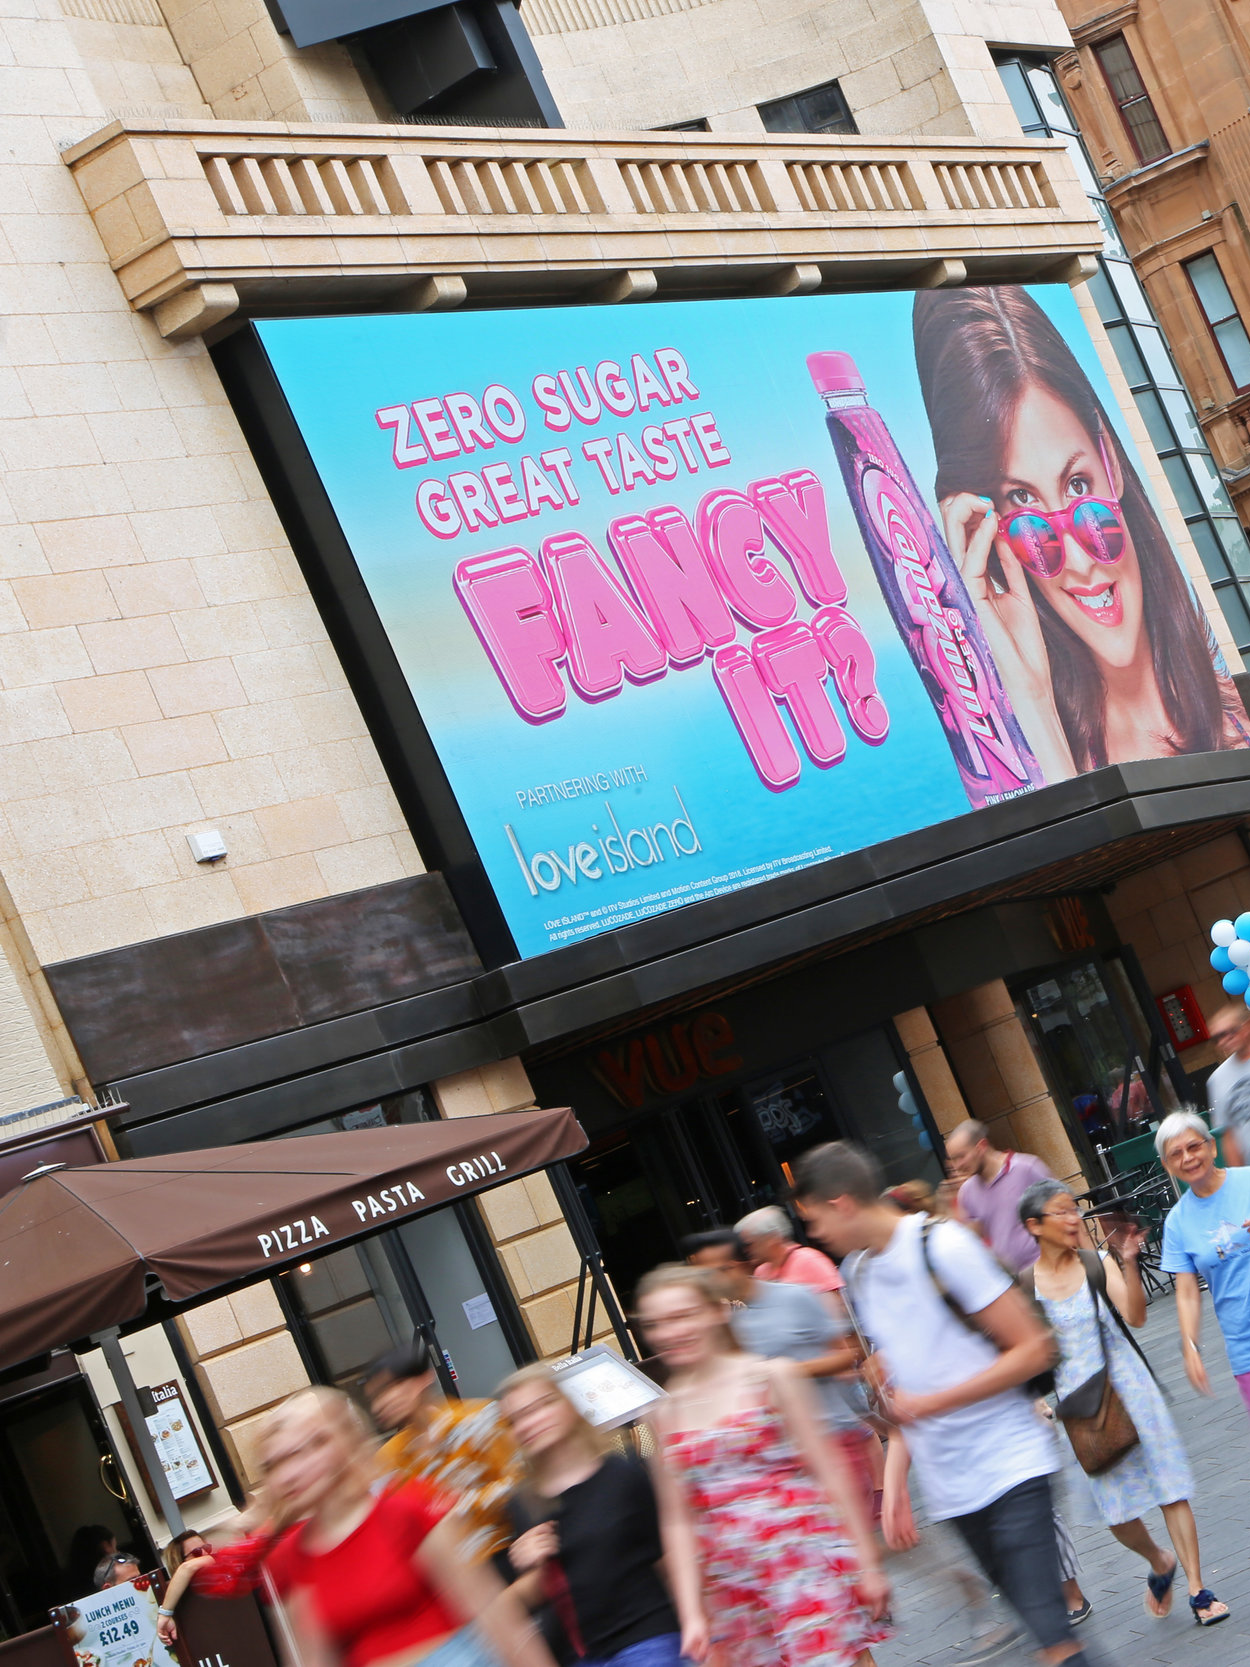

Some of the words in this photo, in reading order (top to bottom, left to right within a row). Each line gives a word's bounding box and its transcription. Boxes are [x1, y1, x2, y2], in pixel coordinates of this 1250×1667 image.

[376, 384, 527, 469] ZERO
[532, 347, 700, 432] SUGAR
[416, 447, 580, 539] GREAT
[583, 412, 731, 493] TASTE
[452, 469, 847, 725] FANCY
[897, 530, 996, 740] Lucozade
[947, 609, 978, 674] ZERO
[712, 607, 890, 793] IT?
[516, 773, 610, 810] PARTNERING
[608, 764, 648, 790] WITH
[544, 918, 561, 931] LOVE
[617, 898, 640, 911] Studios
[639, 892, 661, 904] Limited
[660, 889, 672, 899] and
[671, 883, 691, 895] Motion
[690, 878, 712, 891] Content
[712, 874, 729, 889] Group
[743, 863, 767, 878] Licensed
[781, 851, 814, 867] Broadcasting
[813, 845, 833, 857] Limited.
[549, 931, 558, 942] All
[557, 927, 575, 941] rights
[574, 920, 601, 936] reserved.
[635, 902, 668, 919] LUCOZADE
[668, 897, 684, 910] ZERO
[694, 891, 704, 901] the
[714, 883, 732, 896] Device
[597, 1012, 744, 1108] vue
[258, 1215, 330, 1258] PIZZA
[352, 1181, 426, 1222] PASTA
[445, 1151, 507, 1188] GRILL
[85, 1606, 111, 1623] LUNCH
[113, 1596, 136, 1613] MENU
[99, 1620, 140, 1647] £12.49
[101, 1621, 106, 1629] 2
[105, 1613, 129, 1627] COURSES
